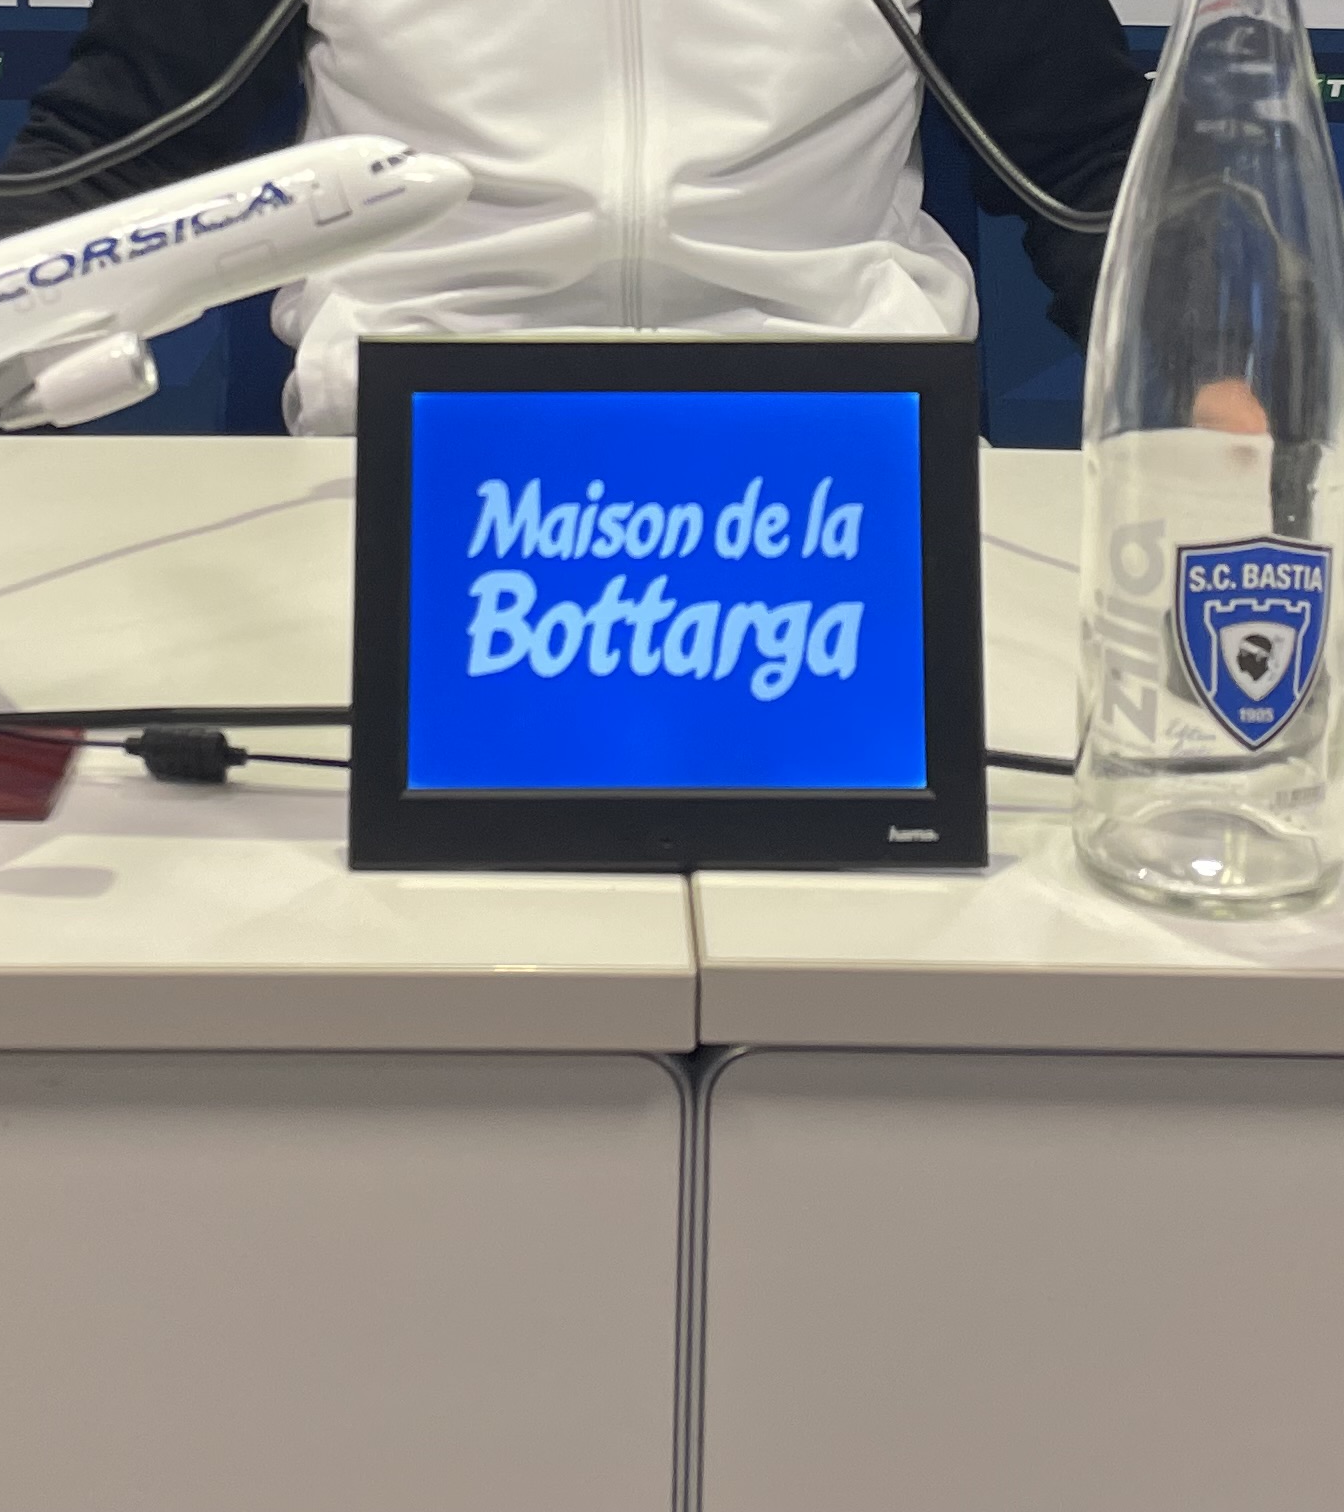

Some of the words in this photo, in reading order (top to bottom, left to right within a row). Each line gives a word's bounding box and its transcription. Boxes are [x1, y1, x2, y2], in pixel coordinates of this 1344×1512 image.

[468, 479, 703, 560] Maison
[716, 477, 791, 560] de
[802, 477, 864, 560] la
[1189, 564, 1236, 592] S.C.
[1242, 564, 1323, 592] BASTIA
[467, 569, 865, 701] Bottarga
